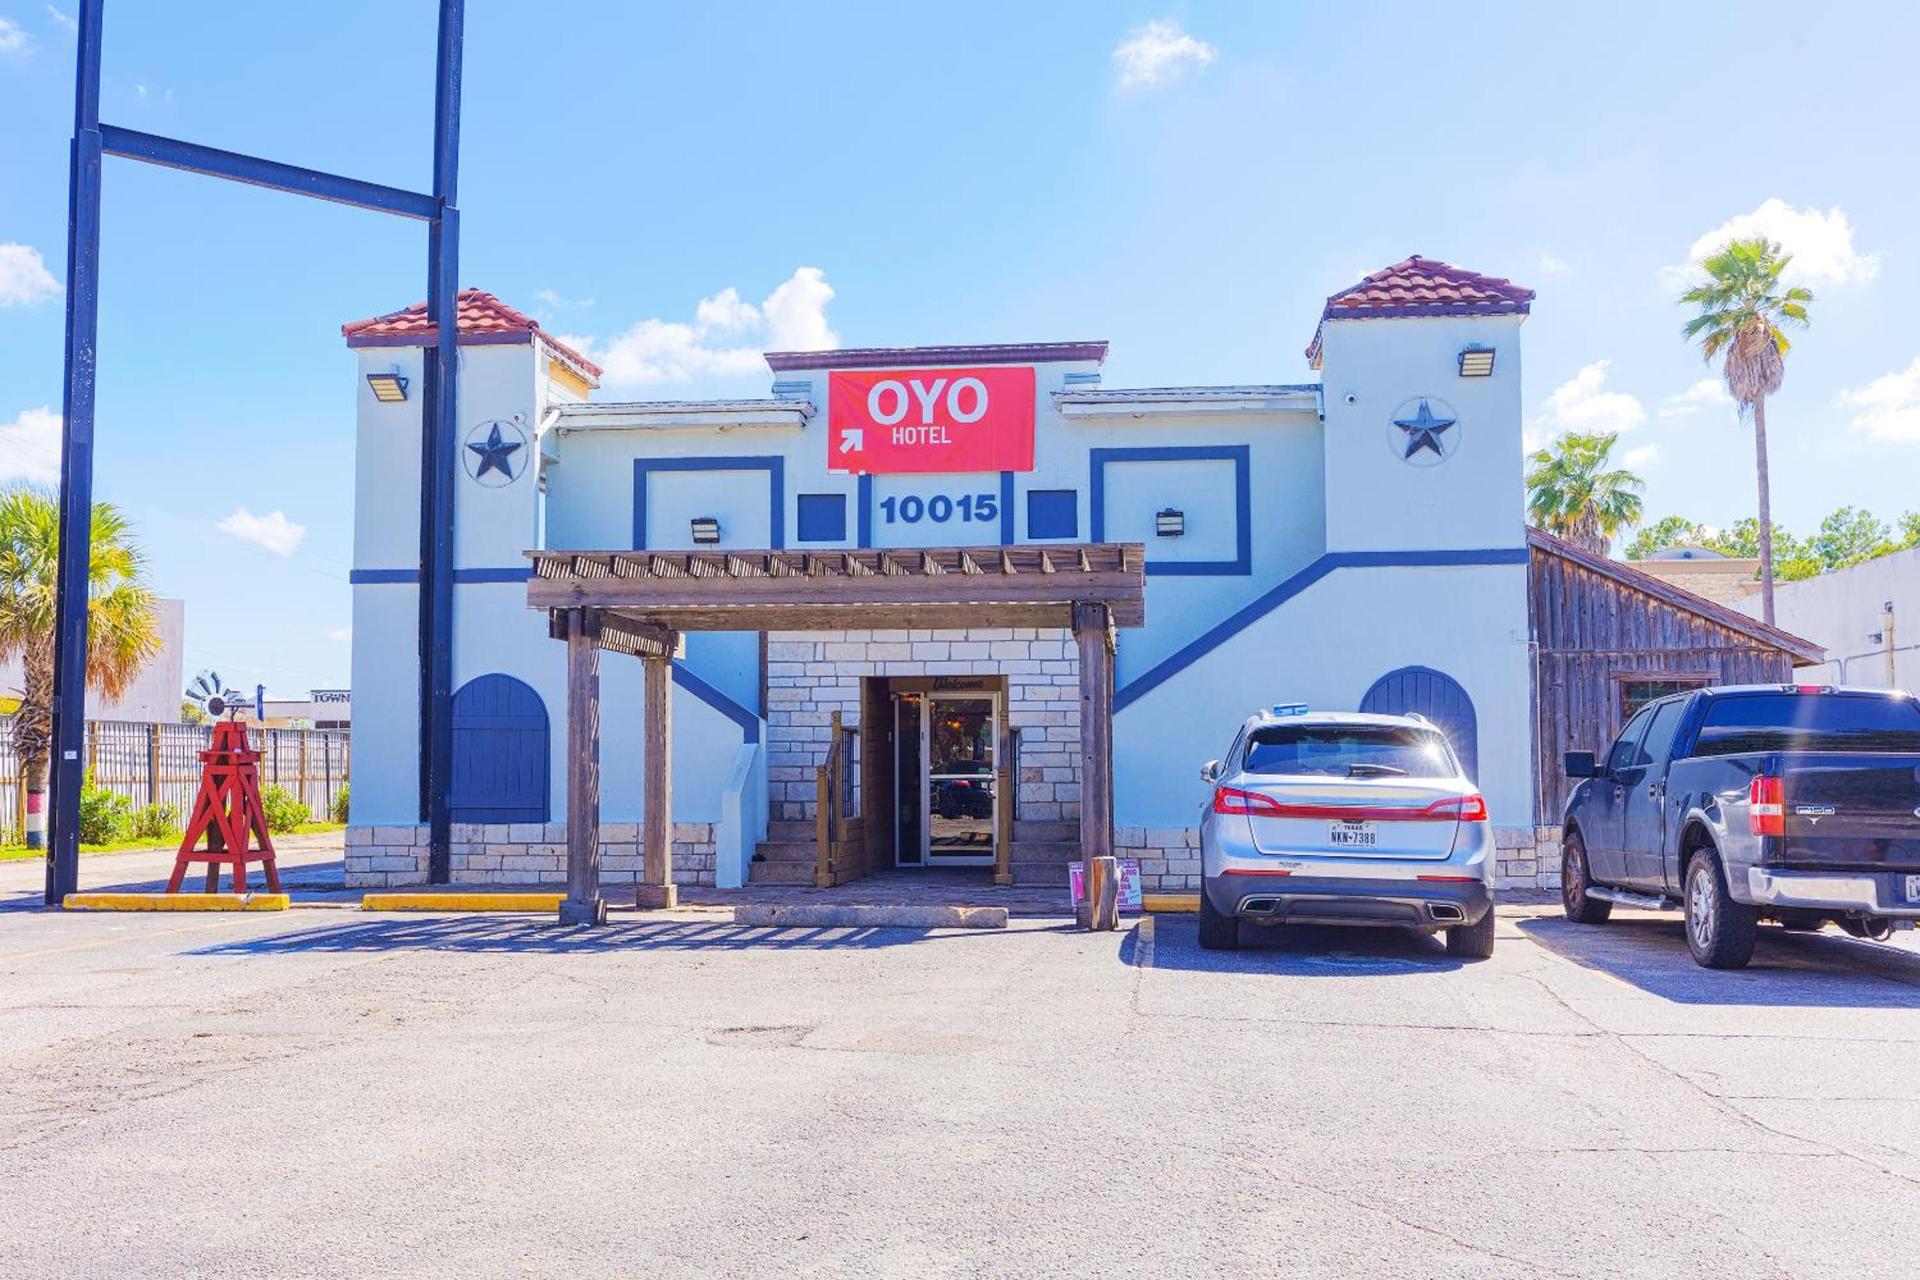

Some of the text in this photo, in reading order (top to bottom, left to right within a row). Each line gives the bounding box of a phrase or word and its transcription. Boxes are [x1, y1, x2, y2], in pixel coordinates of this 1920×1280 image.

[867, 377, 989, 425] OYO
[892, 426, 952, 445] HOTEL
[880, 494, 998, 523] 10015
